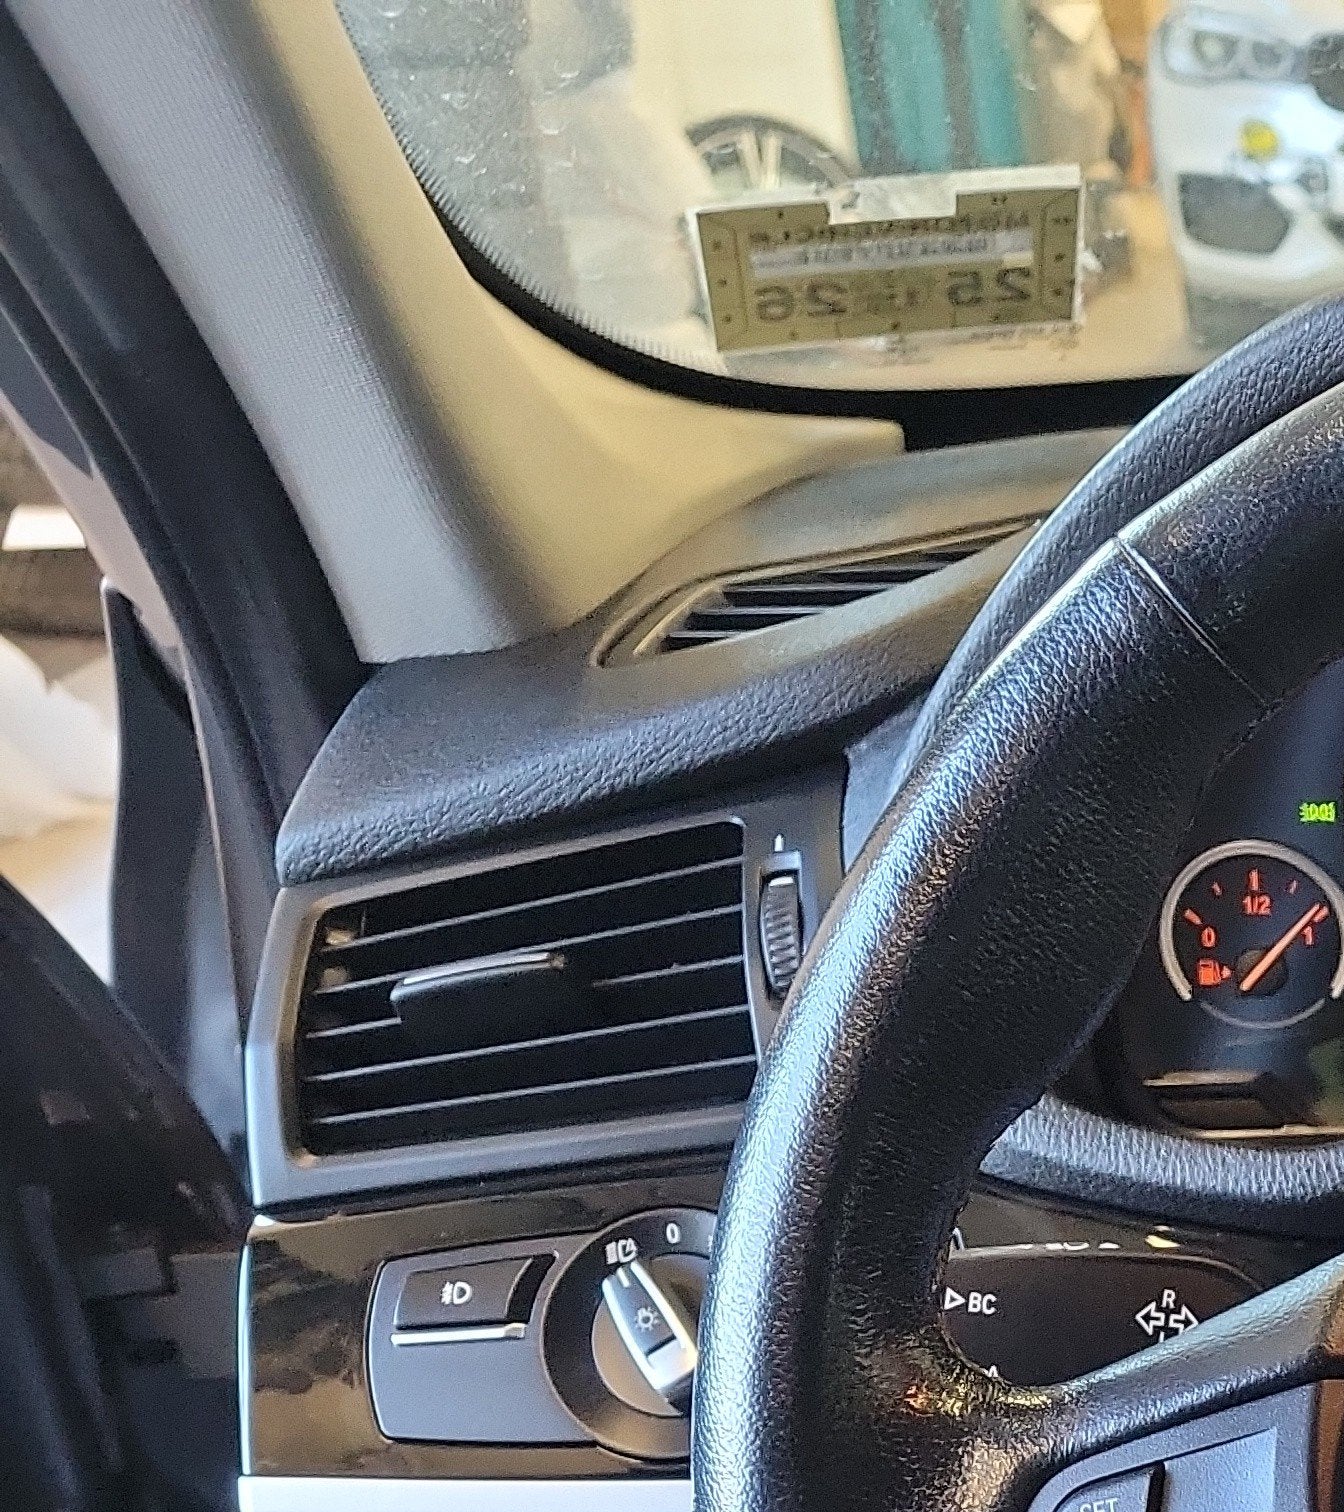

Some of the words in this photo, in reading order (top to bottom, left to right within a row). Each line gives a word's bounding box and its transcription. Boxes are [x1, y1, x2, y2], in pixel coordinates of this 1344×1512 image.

[1242, 893, 1271, 915] 1/2
[1201, 925, 1216, 948] 0
[1302, 924, 1314, 946] 1
[968, 1292, 997, 1315] BC
[1161, 1289, 1176, 1309] R
